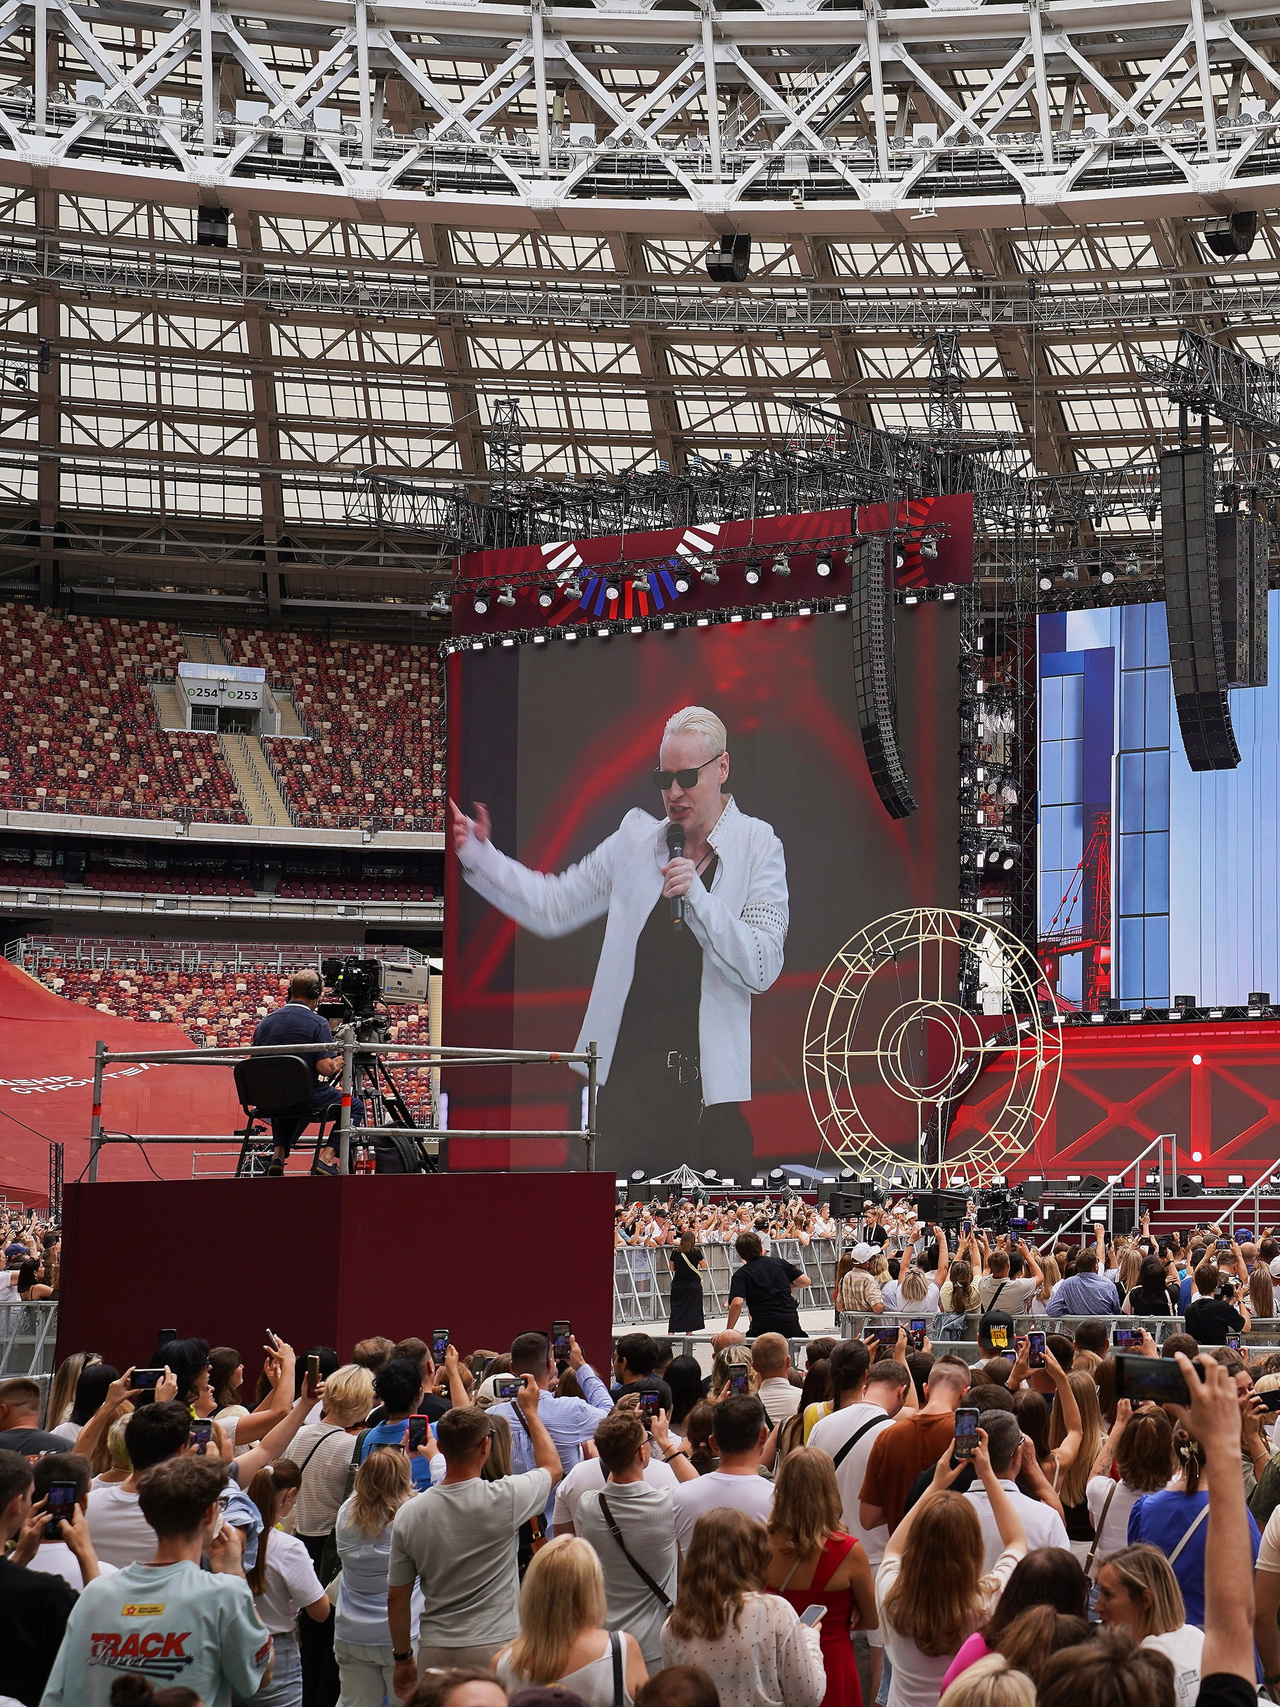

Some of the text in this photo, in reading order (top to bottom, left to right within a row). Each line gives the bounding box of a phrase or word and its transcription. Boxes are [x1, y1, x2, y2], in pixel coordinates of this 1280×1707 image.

[196, 687, 218, 698] 254
[236, 690, 258, 700] 253
[91, 1631, 193, 1658] TRACK
